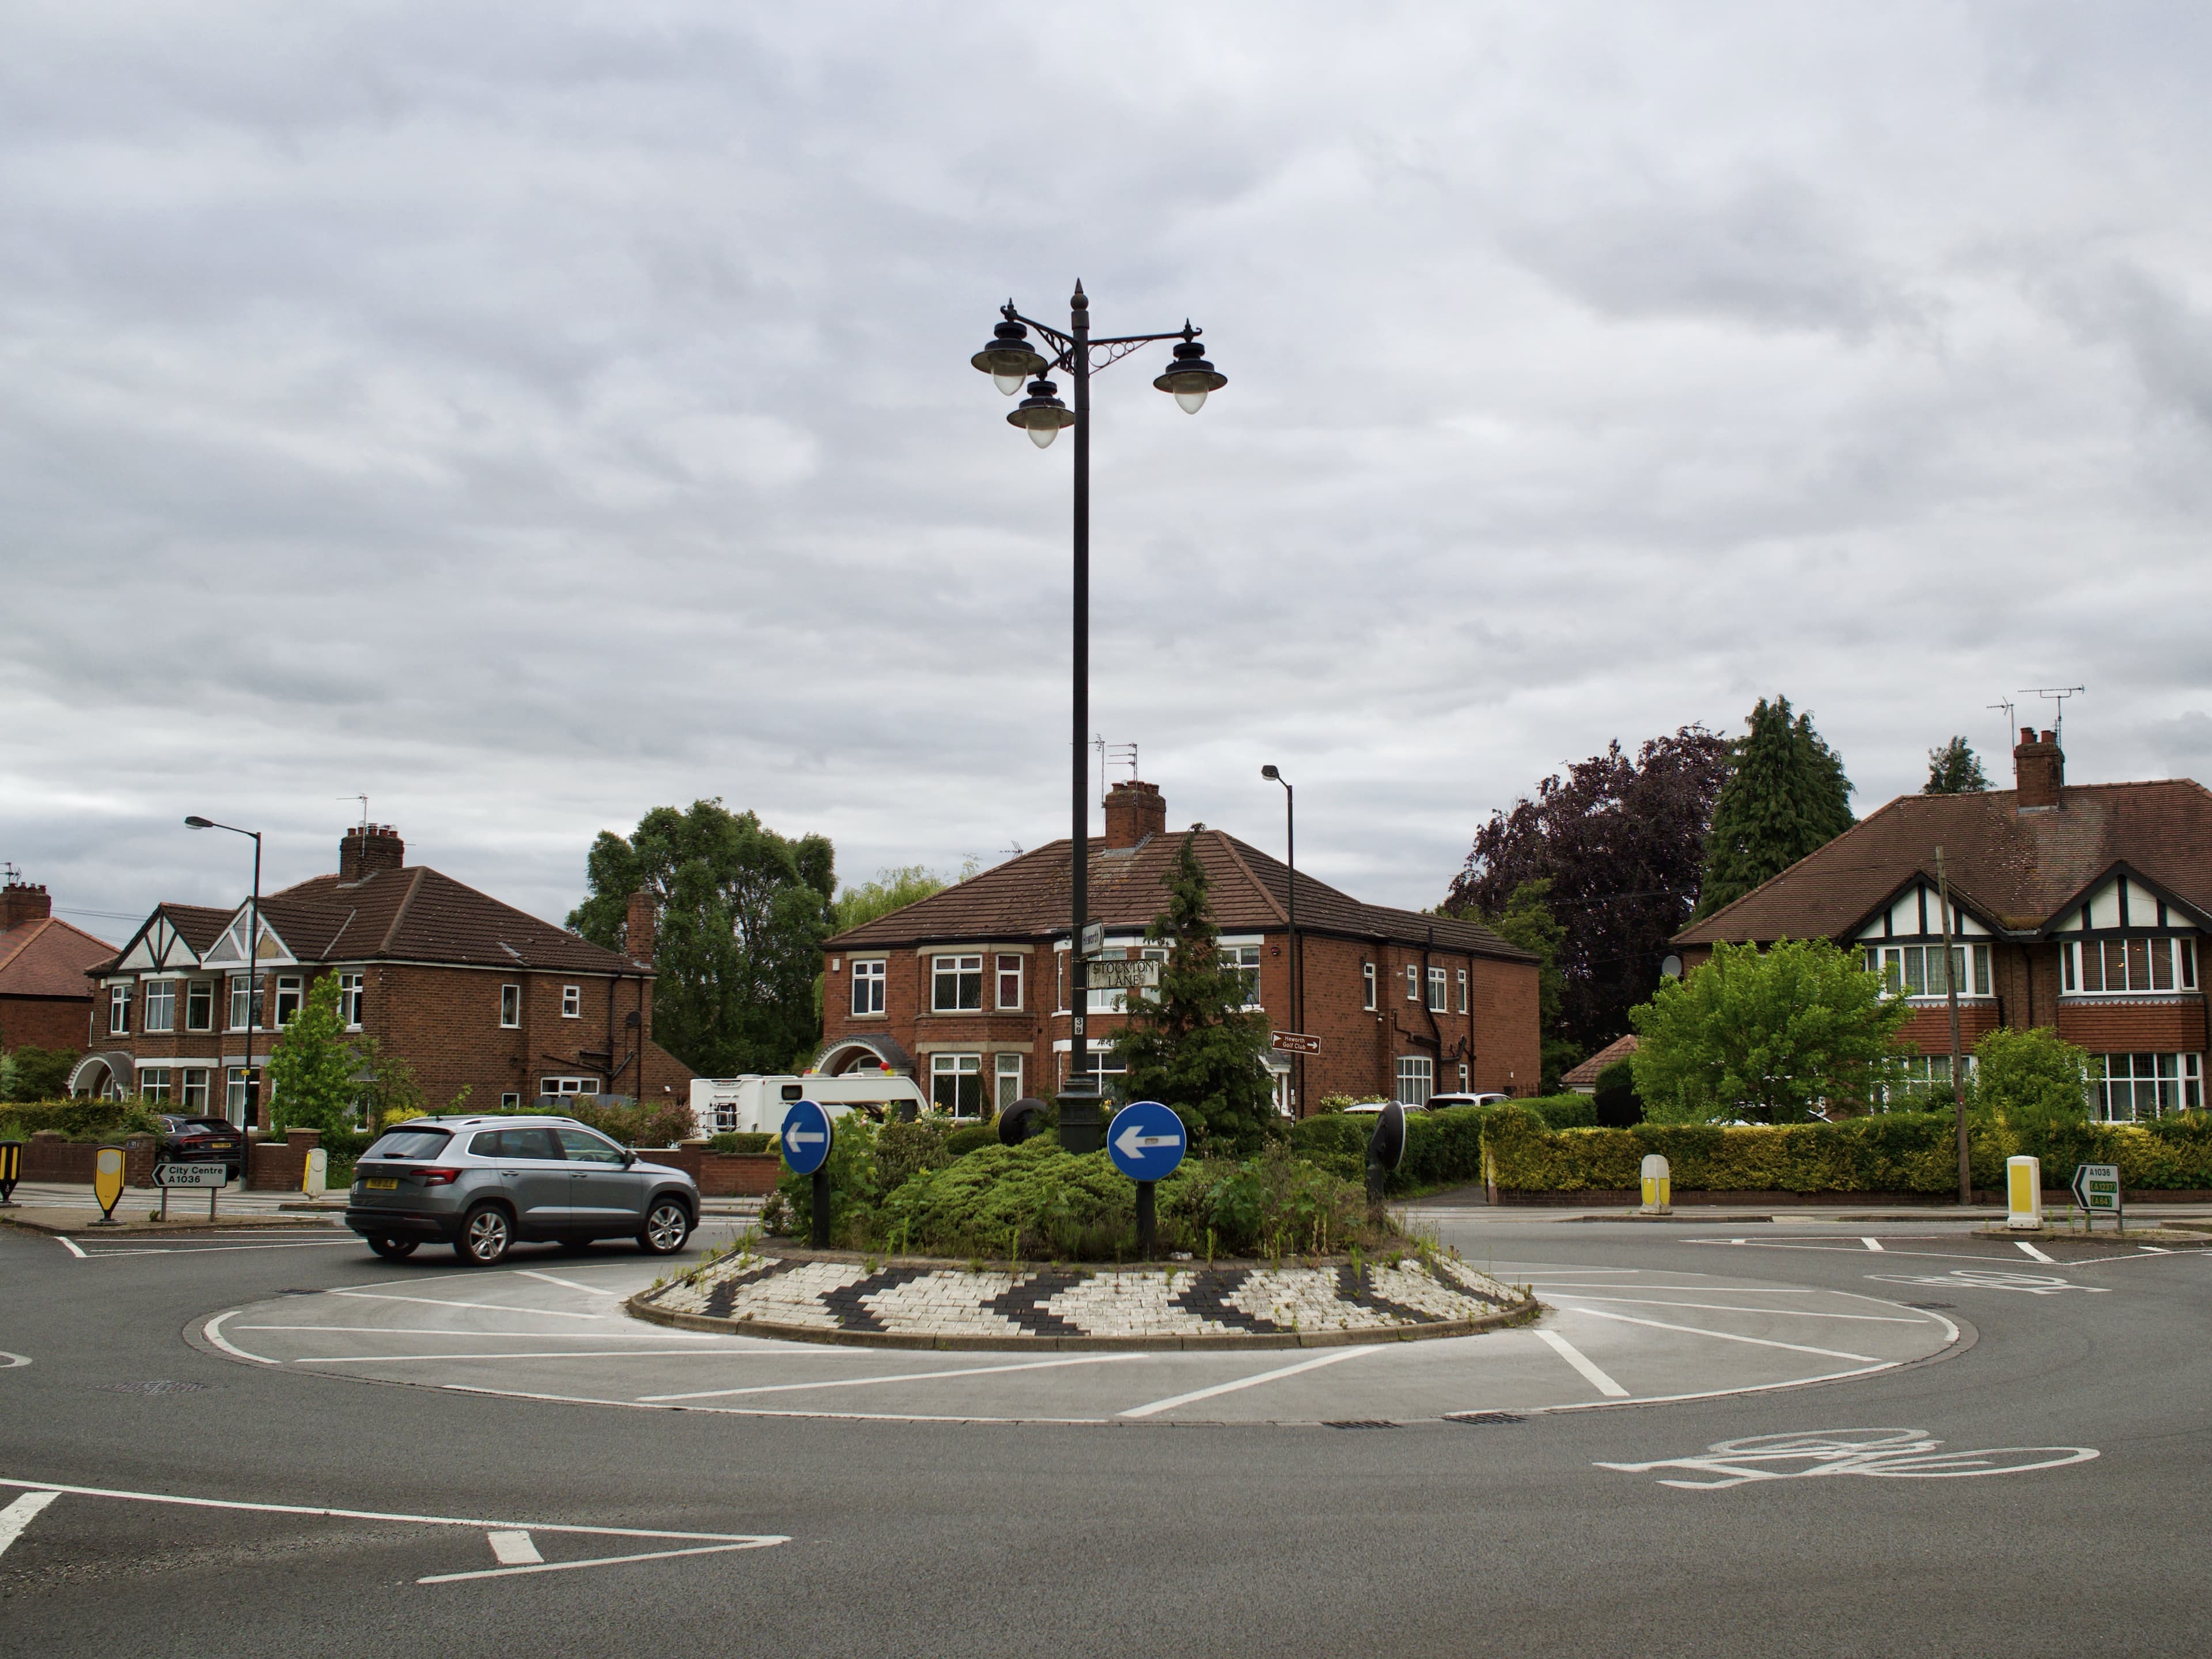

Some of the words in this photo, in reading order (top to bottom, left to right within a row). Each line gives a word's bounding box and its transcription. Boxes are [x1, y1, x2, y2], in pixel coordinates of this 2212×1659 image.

[1093, 962, 1153, 974] STOCKTON
[1108, 975, 1139, 986] LANE
[1285, 1035, 1305, 1043] Heworth
[169, 1166, 188, 1175] City
[2090, 1168, 2110, 1176] A1036
[2091, 1183, 2116, 1191] (A1237)
[2092, 1196, 2111, 1205] (A64)
